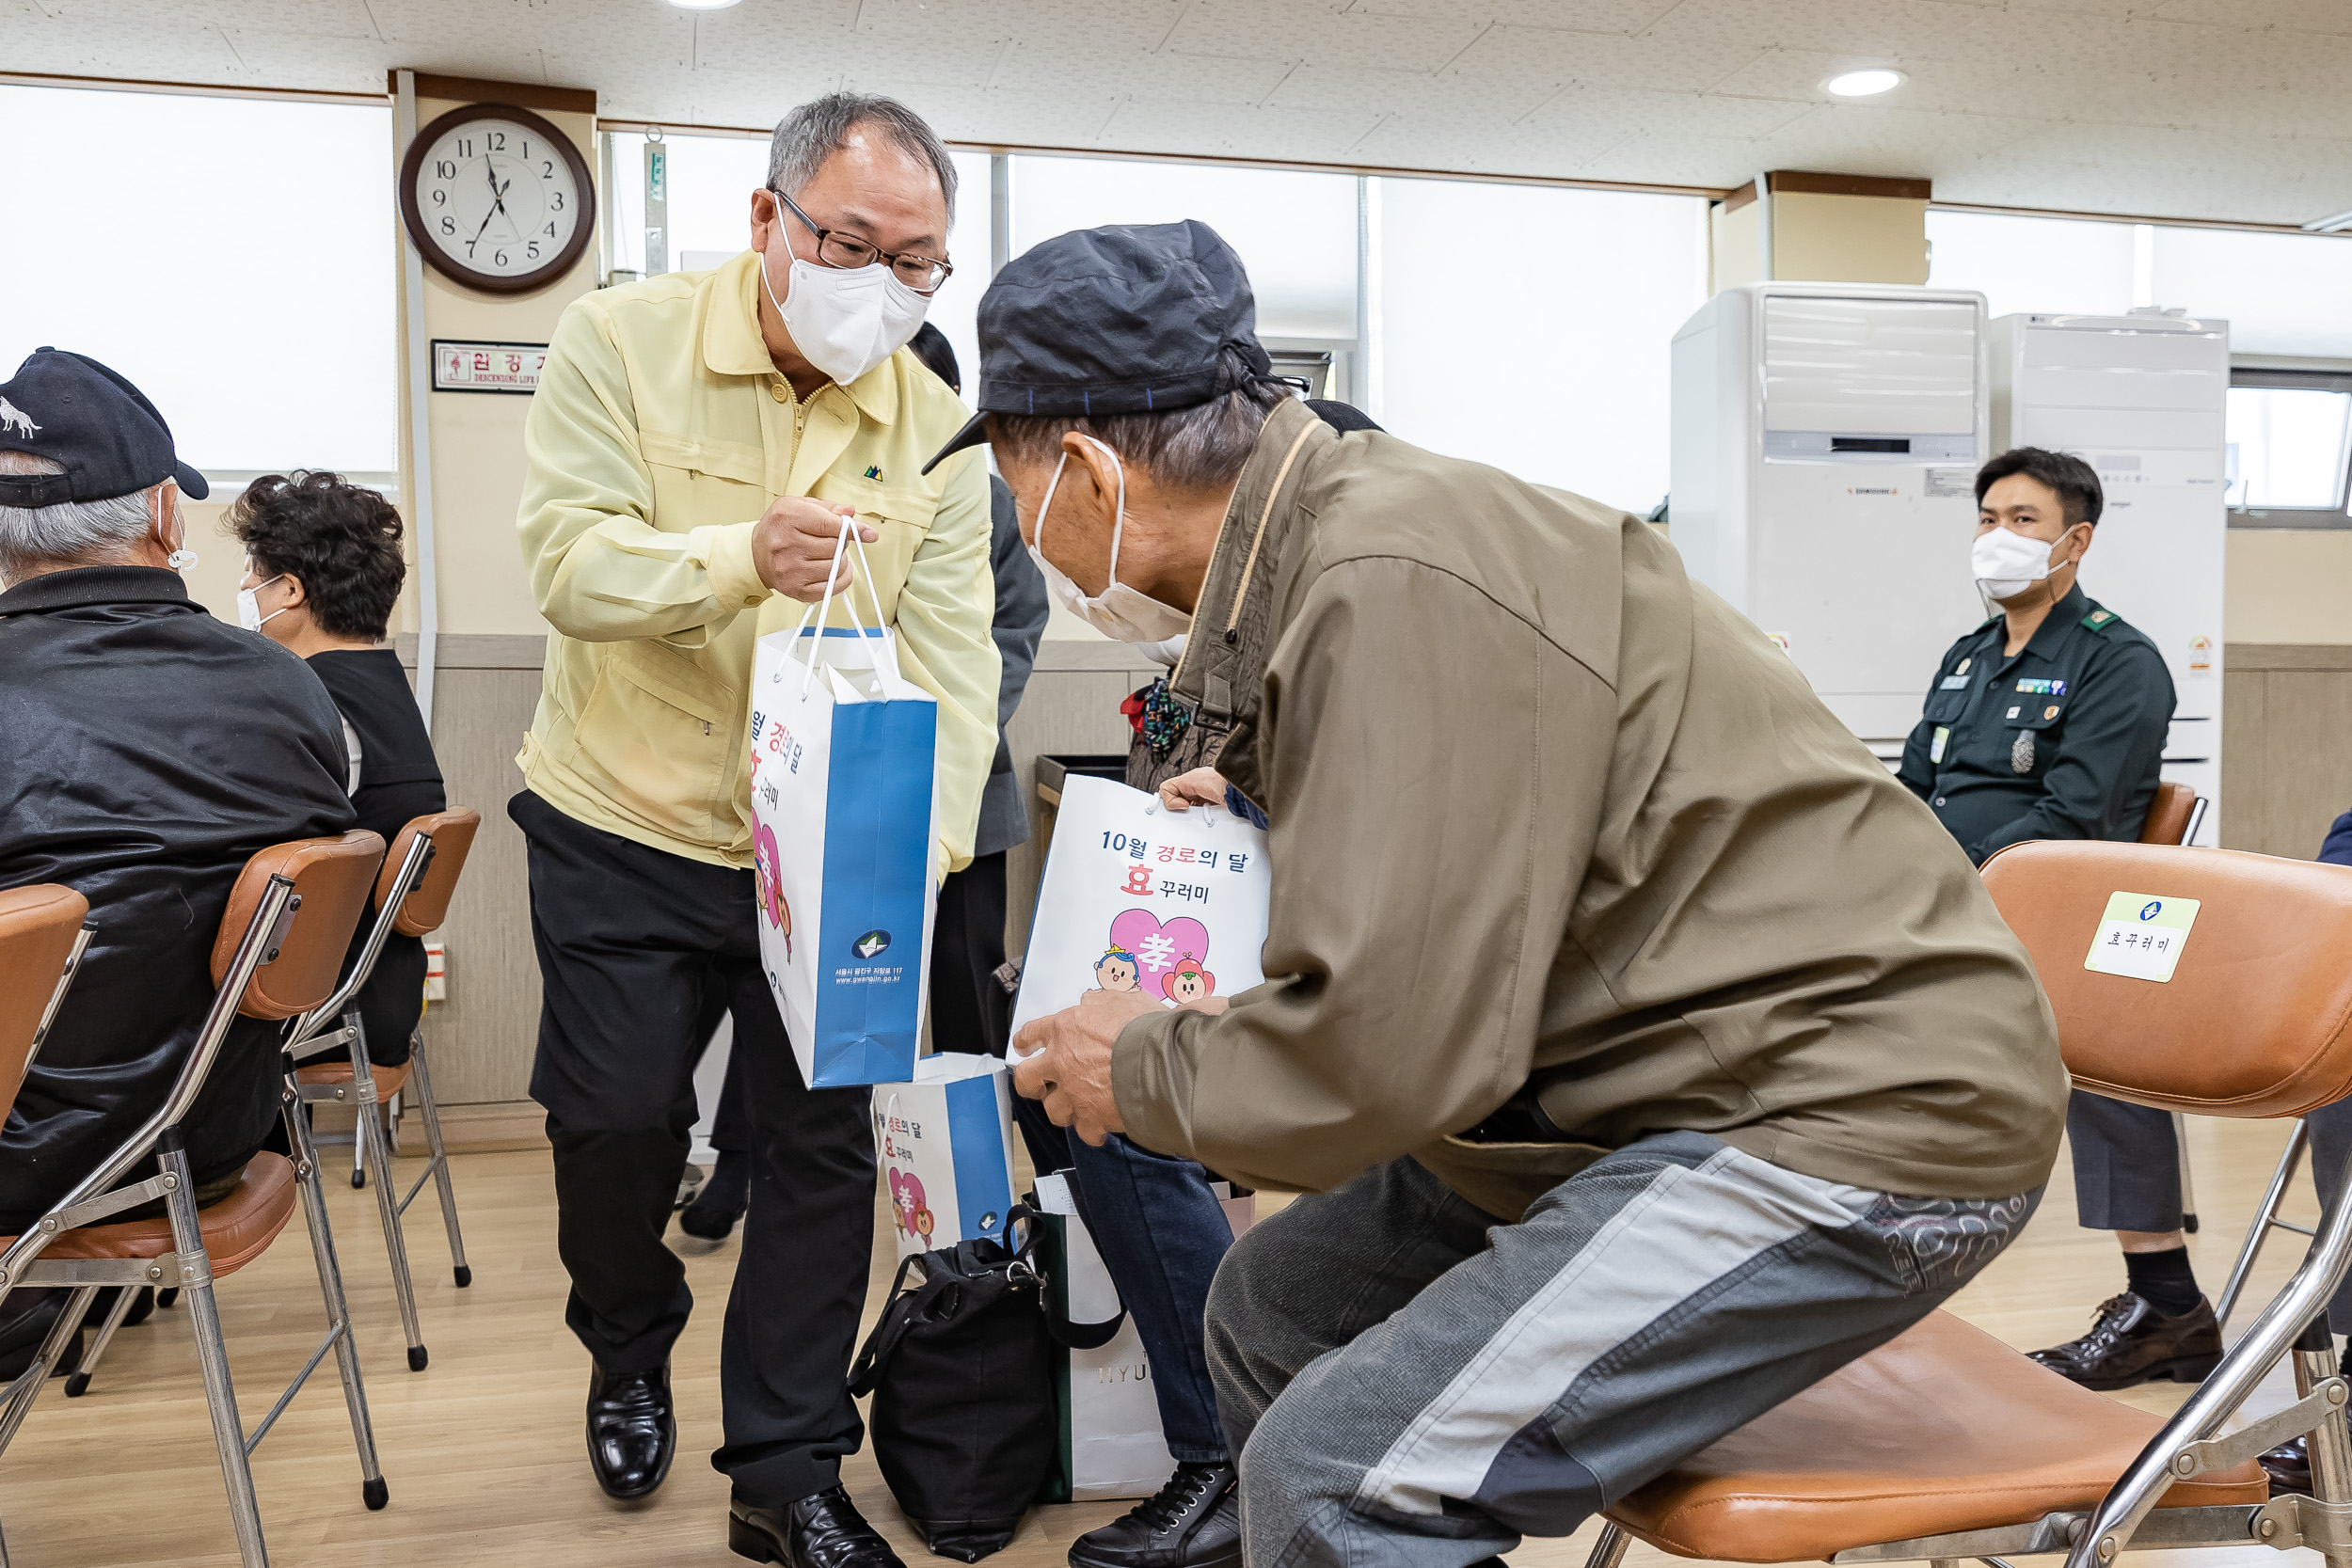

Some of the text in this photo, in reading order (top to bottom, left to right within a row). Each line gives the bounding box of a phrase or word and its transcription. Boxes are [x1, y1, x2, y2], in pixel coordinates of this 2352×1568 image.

[457, 139, 472, 158] 11
[486, 133, 506, 151] 12
[522, 141, 529, 160] 1
[437, 160, 456, 180] 10
[542, 161, 553, 179] 2
[432, 189, 446, 209] 9
[550, 192, 564, 212] 3
[441, 216, 455, 236] 8
[543, 220, 555, 238] 4
[465, 240, 476, 259] 7
[495, 248, 508, 267] 6
[527, 241, 539, 260] 5
[1102, 831, 1249, 874] 10월 경로의 달
[1120, 863, 1210, 905] 효 꾸러미
[1138, 932, 1176, 974] 孝
[834, 967, 853, 976] 서울시
[854, 967, 872, 975] 광진구
[835, 974, 901, 985] www.gwangjin.go.kr
